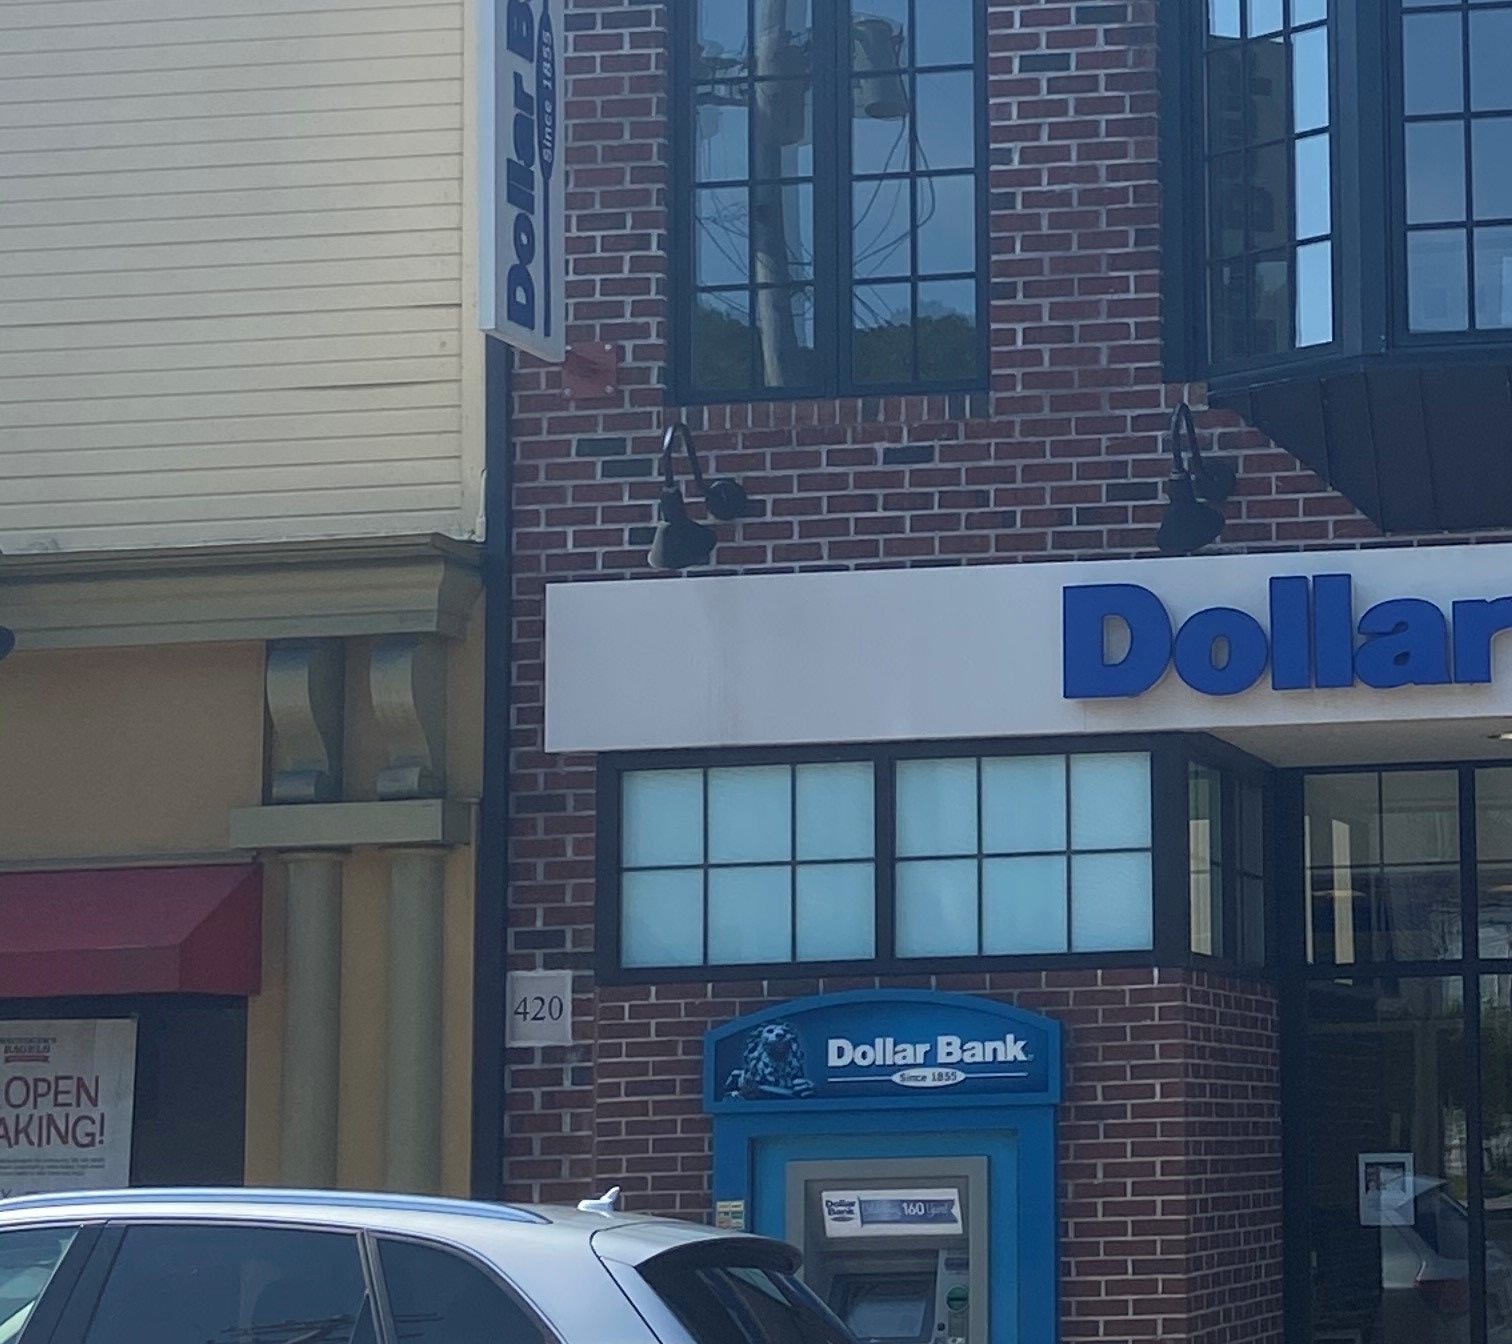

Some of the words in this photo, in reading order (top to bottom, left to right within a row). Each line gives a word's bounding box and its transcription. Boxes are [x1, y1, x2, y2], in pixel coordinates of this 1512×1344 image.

[542, 30, 553, 91] 1855
[542, 99, 553, 163] Since
[506, 70, 536, 332] Dollar
[513, 995, 564, 1022] 420
[827, 1036, 931, 1068] Dollar
[936, 1033, 1029, 1065] Bank
[4, 1074, 100, 1110] OPEN
[899, 1072, 928, 1082] Since
[931, 1071, 958, 1082] 1855
[827, 1207, 855, 1216] Bank
[902, 1202, 925, 1216] 160
